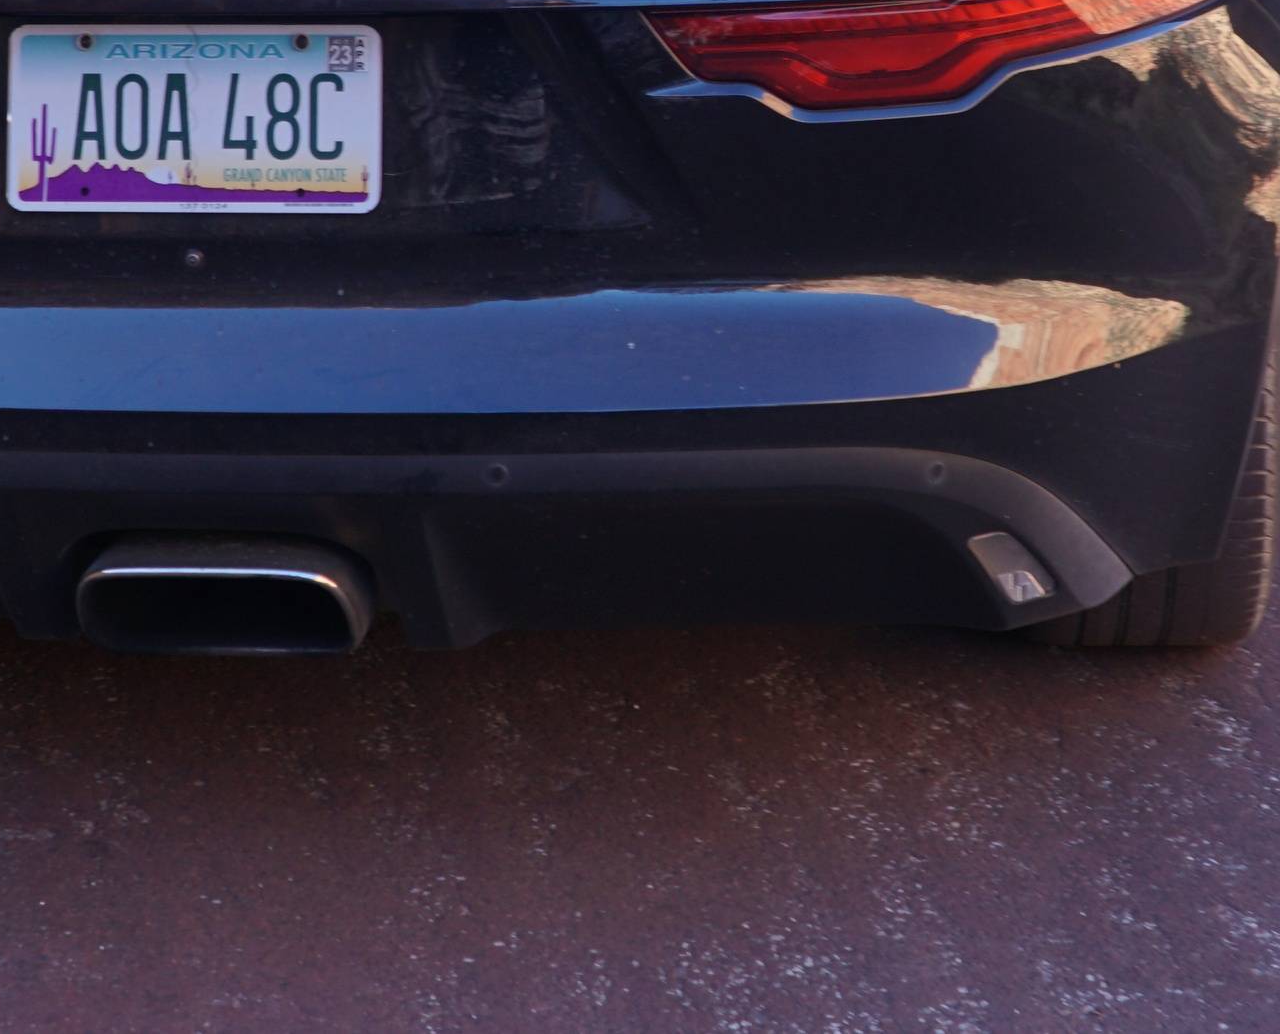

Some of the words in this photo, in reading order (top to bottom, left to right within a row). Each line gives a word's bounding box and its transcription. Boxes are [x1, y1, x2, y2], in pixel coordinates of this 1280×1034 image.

[105, 43, 284, 60] ARIZONA
[329, 45, 353, 65] 23
[354, 38, 366, 71] APR
[222, 73, 344, 161] 48C
[223, 167, 261, 182] GRAND
[266, 167, 312, 182] CANYON
[316, 167, 347, 182] STATE
